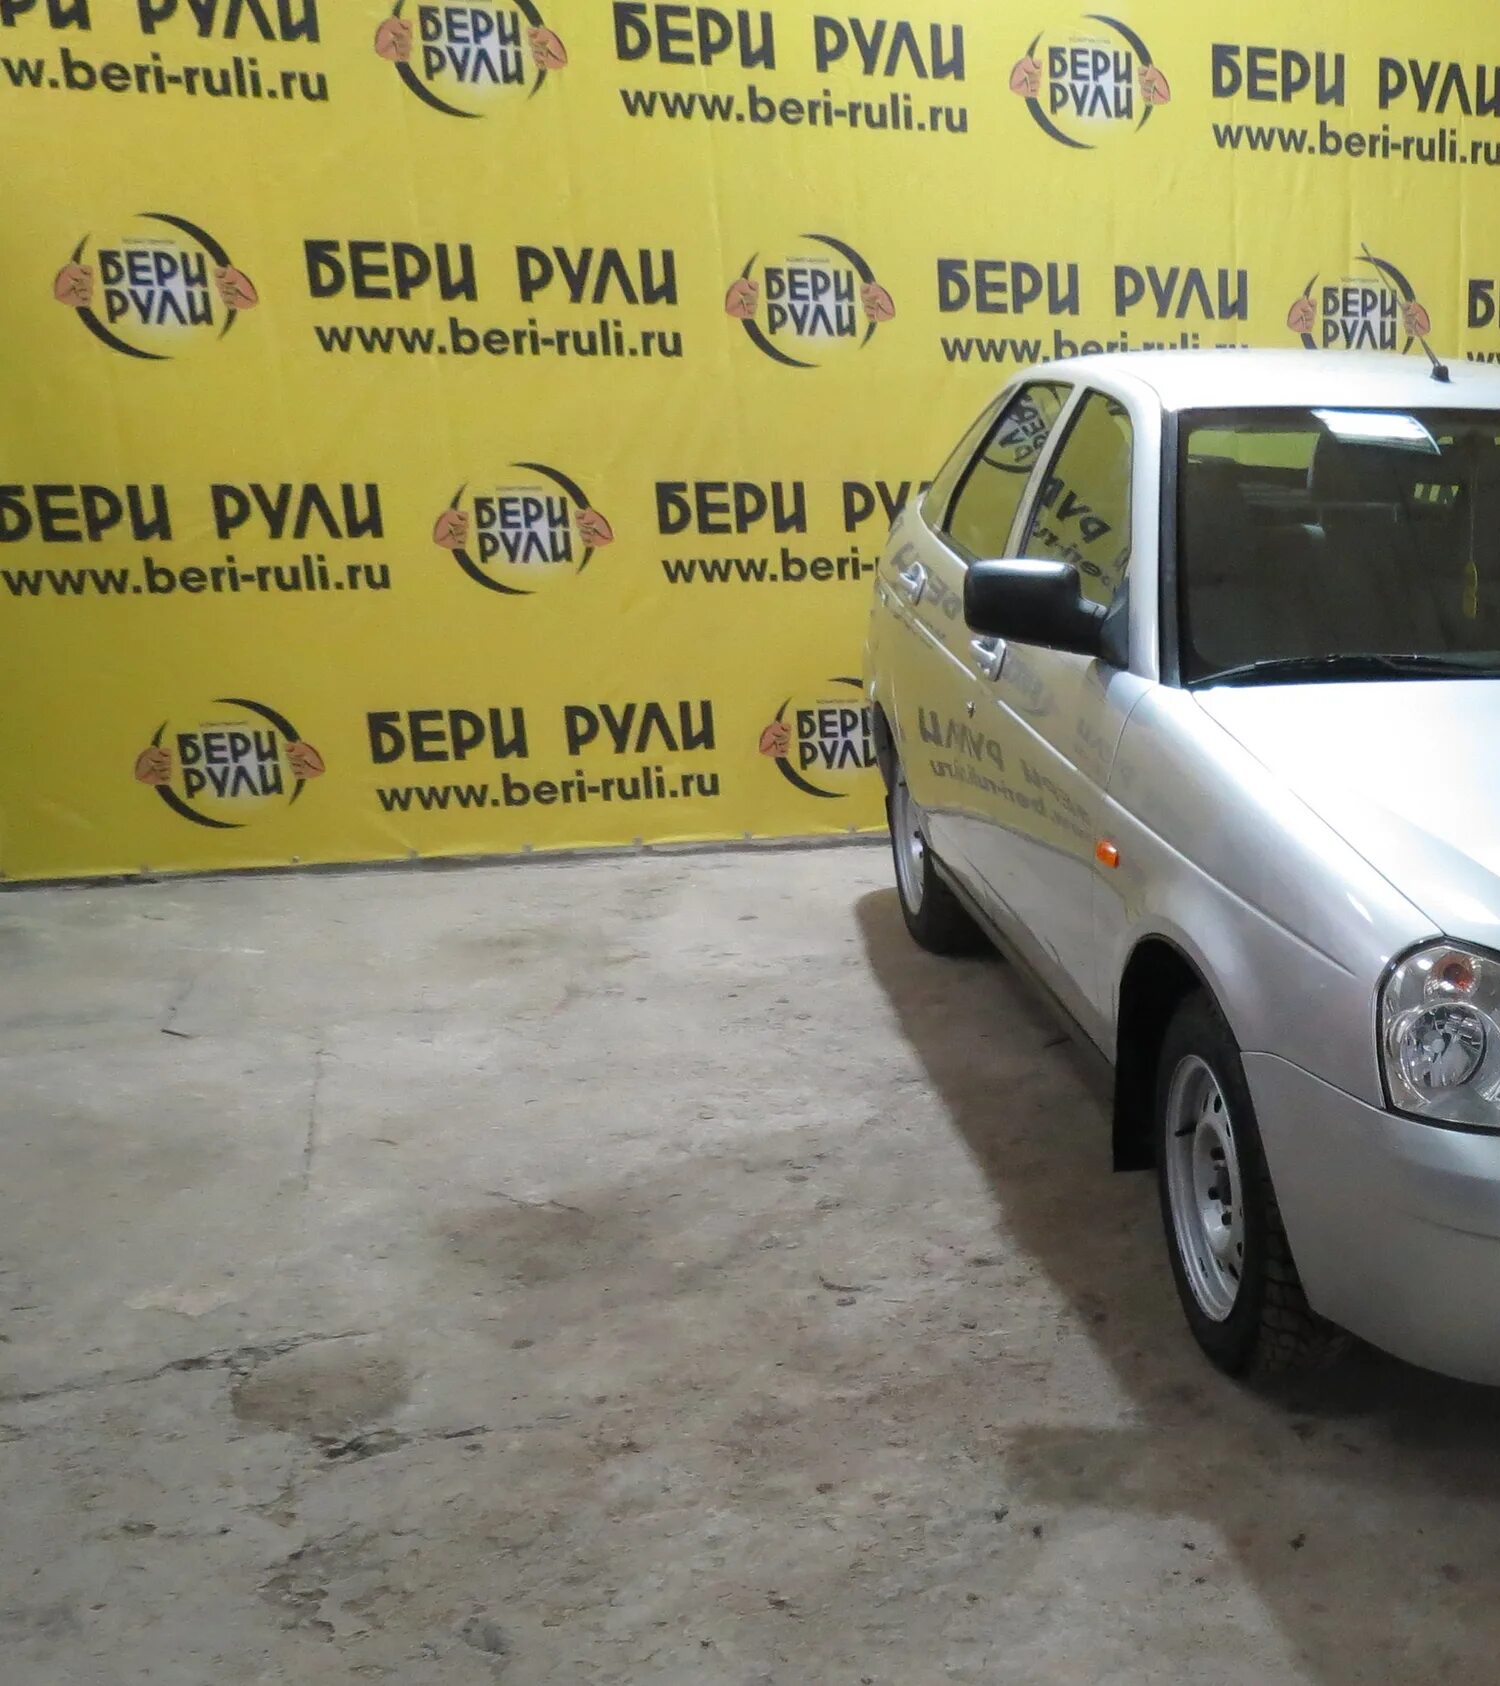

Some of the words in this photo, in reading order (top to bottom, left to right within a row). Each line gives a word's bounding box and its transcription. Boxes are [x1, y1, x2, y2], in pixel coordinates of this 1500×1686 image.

[419, 5, 521, 47] БЕРИ
[613, 2, 775, 69] БЕРИ
[814, 15, 965, 80] РУЛИ
[423, 45, 524, 85] РУЛИ
[1049, 47, 1132, 84] БЕРИ
[1212, 44, 1344, 106] БЕРИ
[620, 85, 967, 133] www.beri-ruli.ru
[1050, 82, 1133, 119] РУЛИ
[98, 250, 207, 288] БЕРИ
[304, 240, 477, 301] БЕРИ
[516, 246, 677, 305] РУЛИ
[765, 268, 854, 302] БЕРИ
[105, 289, 213, 325] РУЛИ
[937, 259, 1079, 315] БЕРИ
[1115, 266, 1247, 320] РУЛИ
[1323, 286, 1397, 318] БЕРИ
[314, 317, 682, 357] www.beri-ruli.ru
[767, 303, 856, 336] РУЛИ
[1323, 318, 1397, 350] РУЛИ
[211, 484, 383, 540] РУЛИ
[474, 497, 569, 529] БЕРИ
[656, 482, 806, 534] БЕРИ
[843, 481, 933, 533] РУ
[478, 531, 572, 563] РУЛИ
[663, 546, 880, 583] www.beri-
[0, 555, 391, 597] www.beri-ruli.ru
[177, 731, 278, 765] БЕРИ
[367, 707, 528, 764] БЕРИ
[564, 700, 715, 755] РУЛИ
[183, 764, 283, 799] РУЛИ
[376, 766, 719, 812] www.beri-ruli.ru
